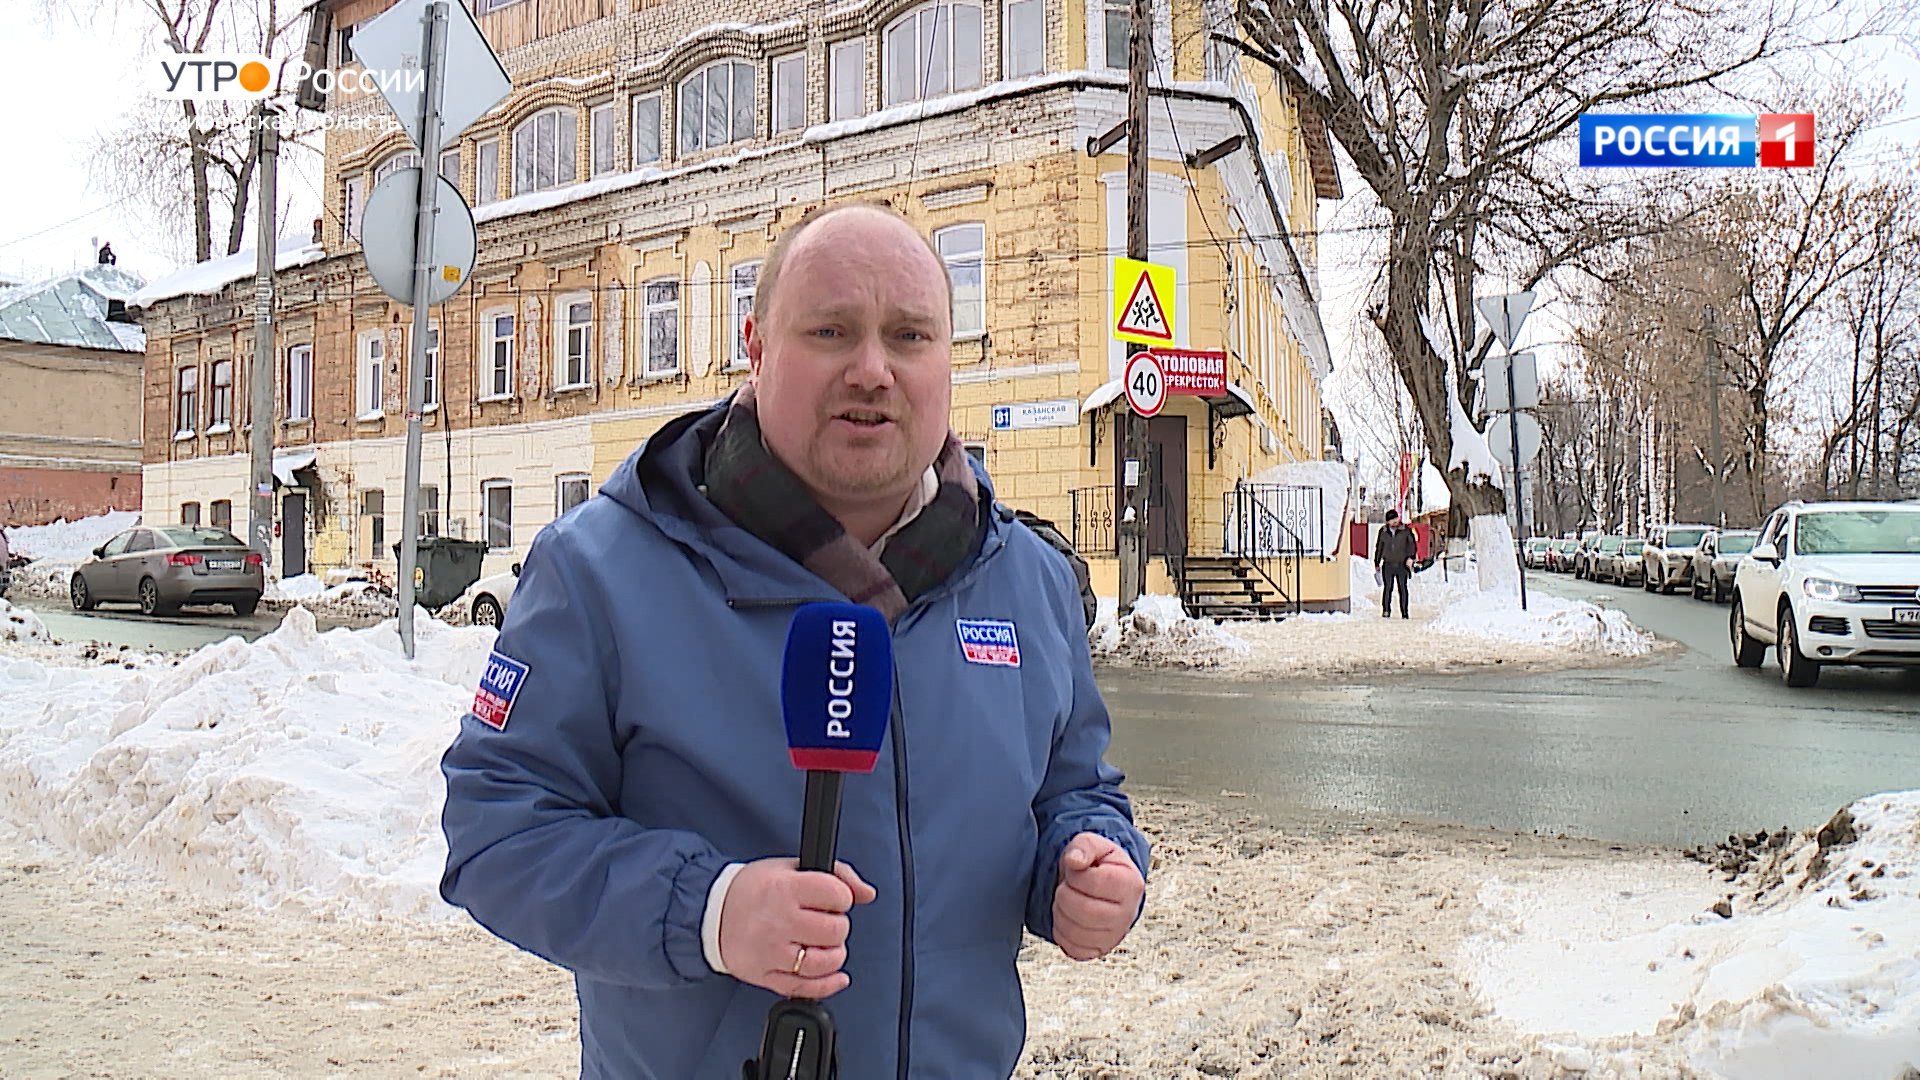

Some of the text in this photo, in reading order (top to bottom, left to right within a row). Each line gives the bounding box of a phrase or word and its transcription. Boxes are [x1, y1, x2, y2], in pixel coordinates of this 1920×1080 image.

[1132, 371, 1158, 397] 40
[962, 625, 1012, 643] РОССИЯ
[483, 659, 517, 694] ССИЯ
[826, 619, 857, 739] РОССИЯ
